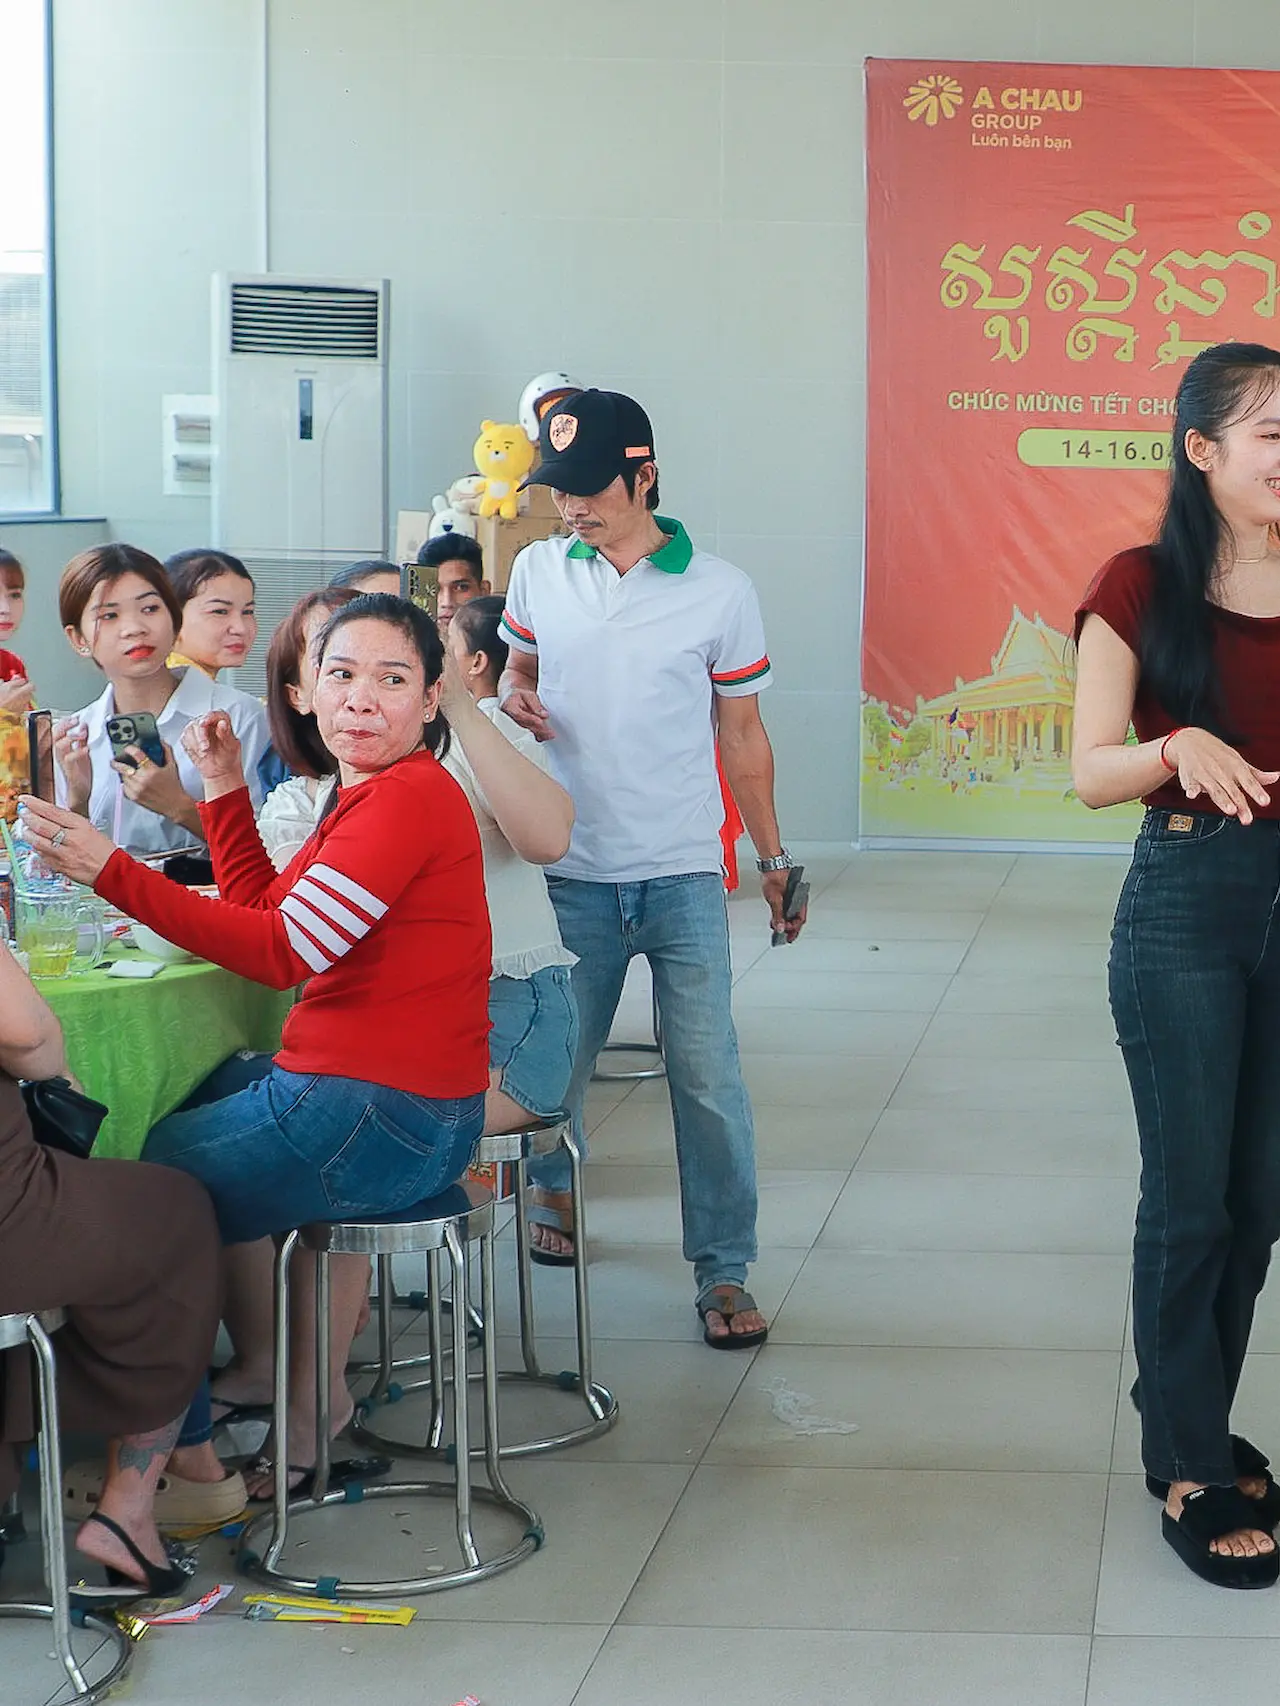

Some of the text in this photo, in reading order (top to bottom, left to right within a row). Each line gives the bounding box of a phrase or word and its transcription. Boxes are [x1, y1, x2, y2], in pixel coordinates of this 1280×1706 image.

[971, 86, 1083, 112] A CHAU
[971, 113, 1043, 131] GROUP
[971, 132, 1073, 151] Luôn bên bạn
[946, 388, 1010, 412] CHÚC
[1015, 390, 1084, 414] MỪNG
[1089, 391, 1132, 415] TẾT
[1062, 439, 1174, 461] 14-16.0
